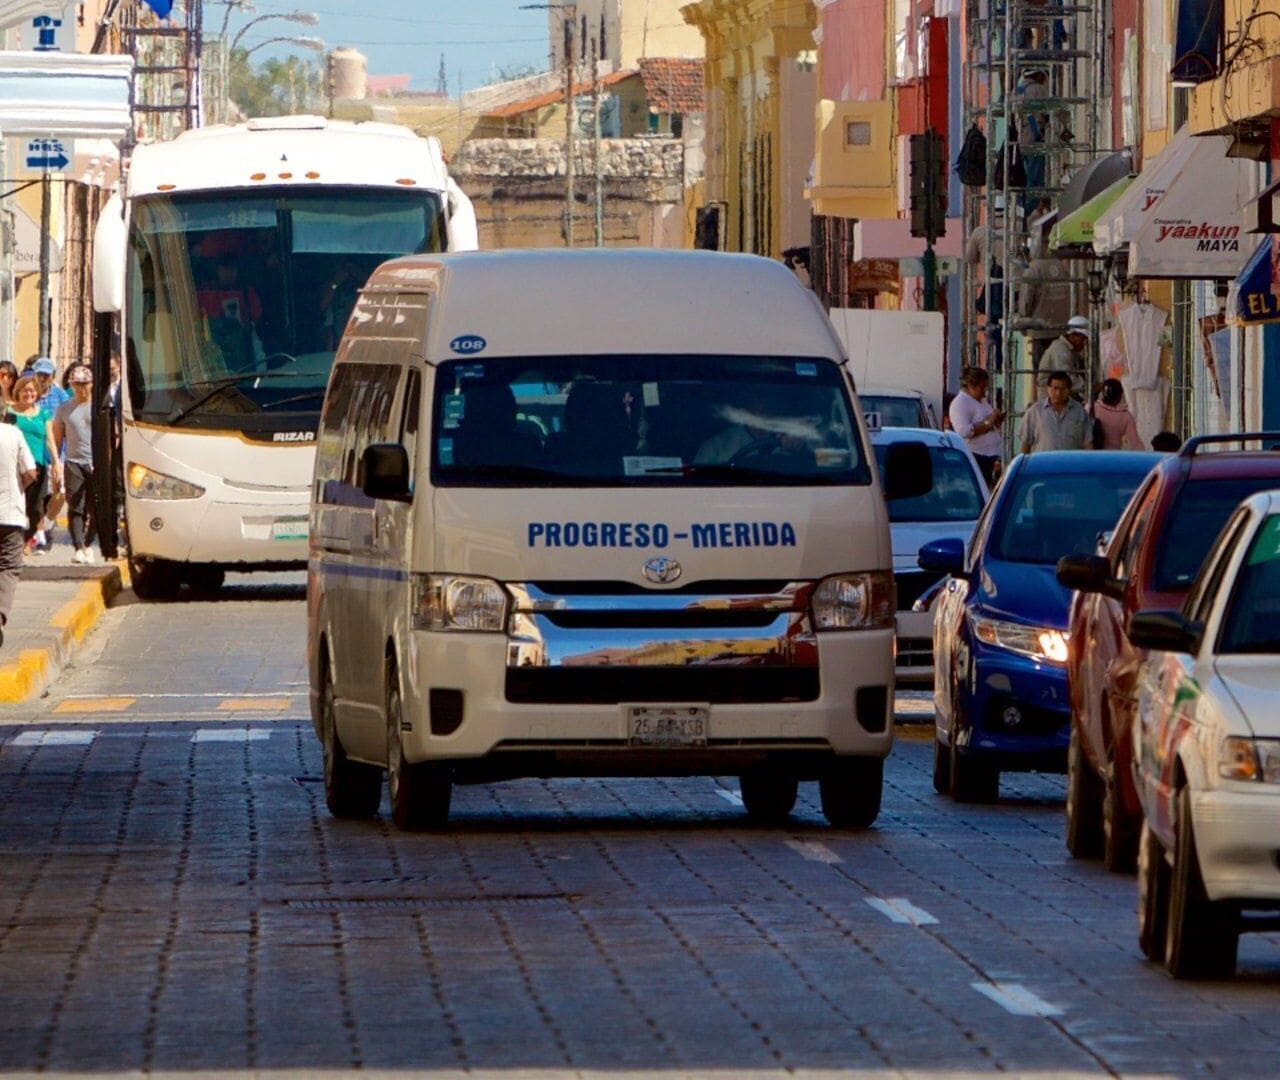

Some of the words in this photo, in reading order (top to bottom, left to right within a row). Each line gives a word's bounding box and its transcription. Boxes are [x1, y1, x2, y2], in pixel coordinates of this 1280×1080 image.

[1156, 222, 1240, 243] yaakun
[1196, 239, 1240, 252] MAYA
[1247, 292, 1271, 315] EL
[451, 339, 485, 351] 108
[272, 432, 315, 442] IRIZAR
